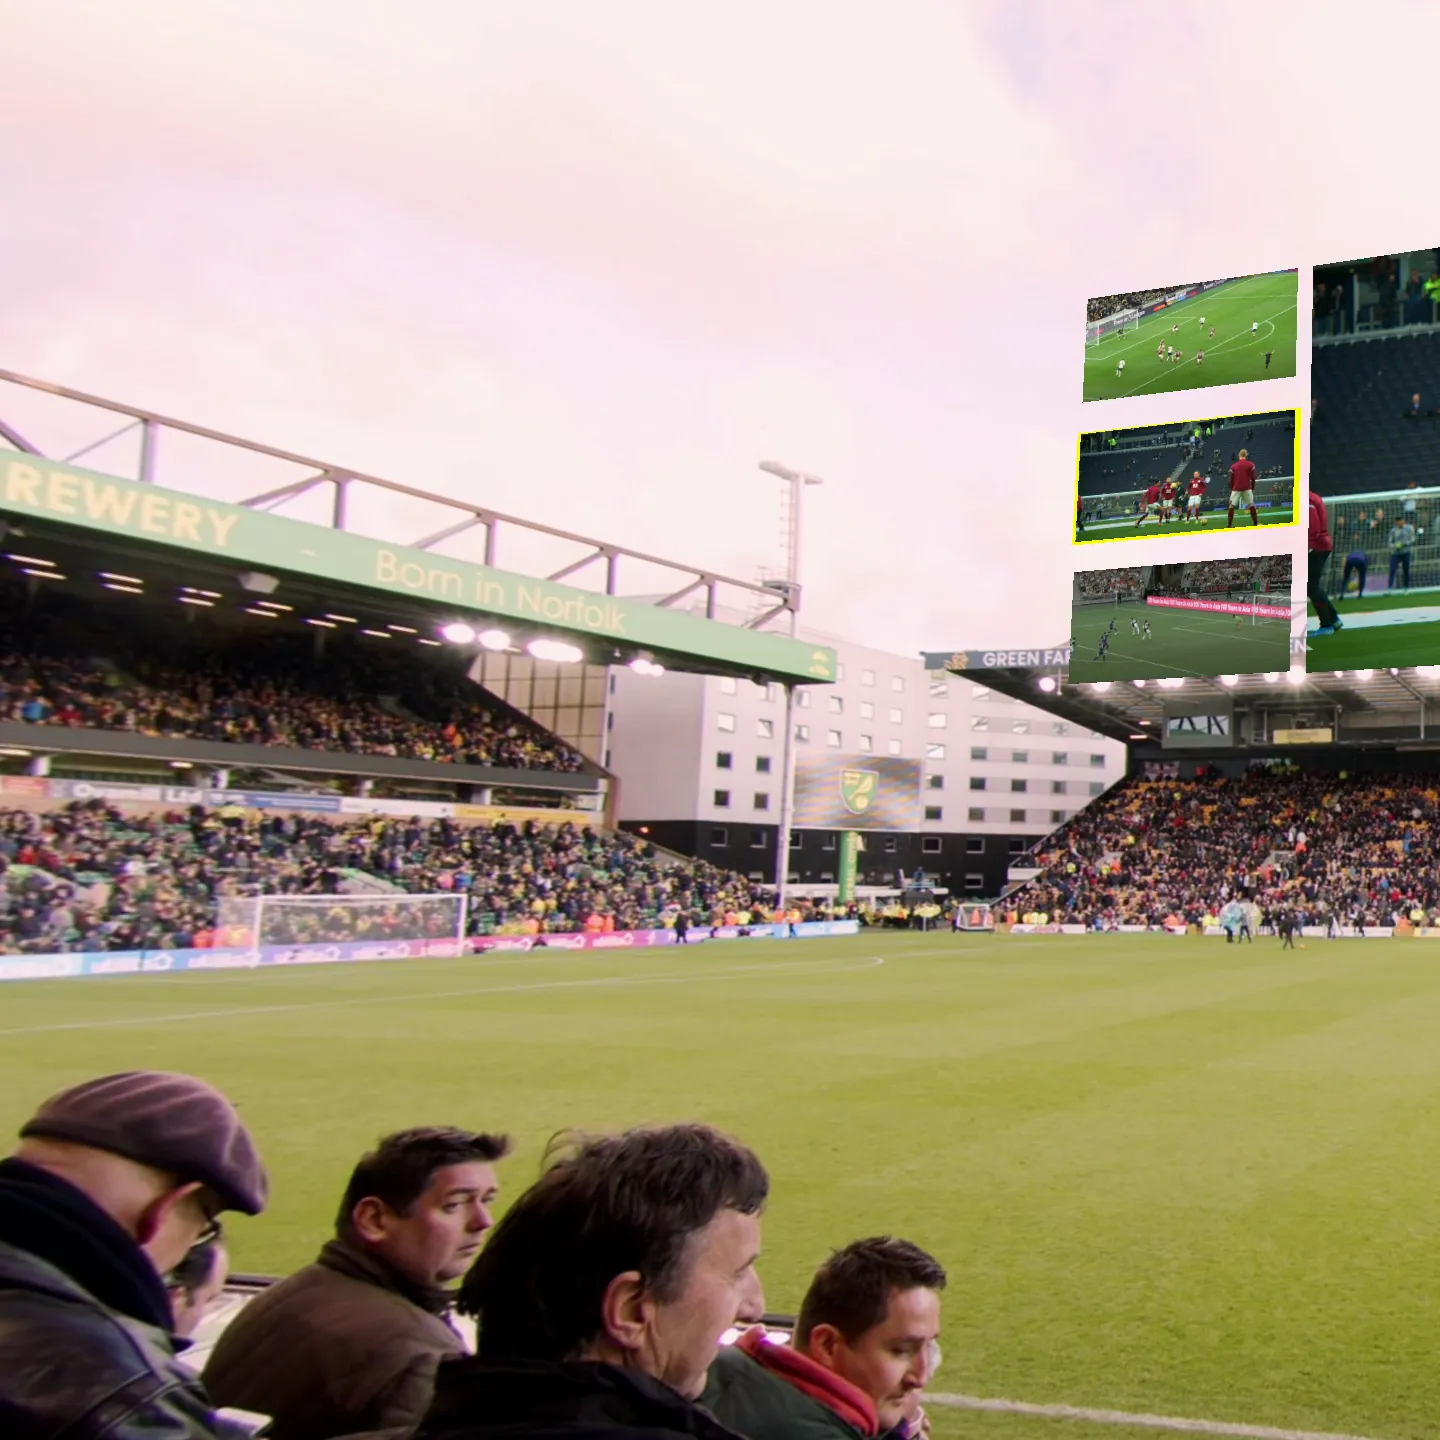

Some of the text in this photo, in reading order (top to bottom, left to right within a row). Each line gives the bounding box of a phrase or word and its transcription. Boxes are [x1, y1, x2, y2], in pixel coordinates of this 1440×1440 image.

[5, 462, 241, 547] REWERY
[374, 549, 627, 635] Born in Norfolk
[982, 651, 1040, 667] GREEN
